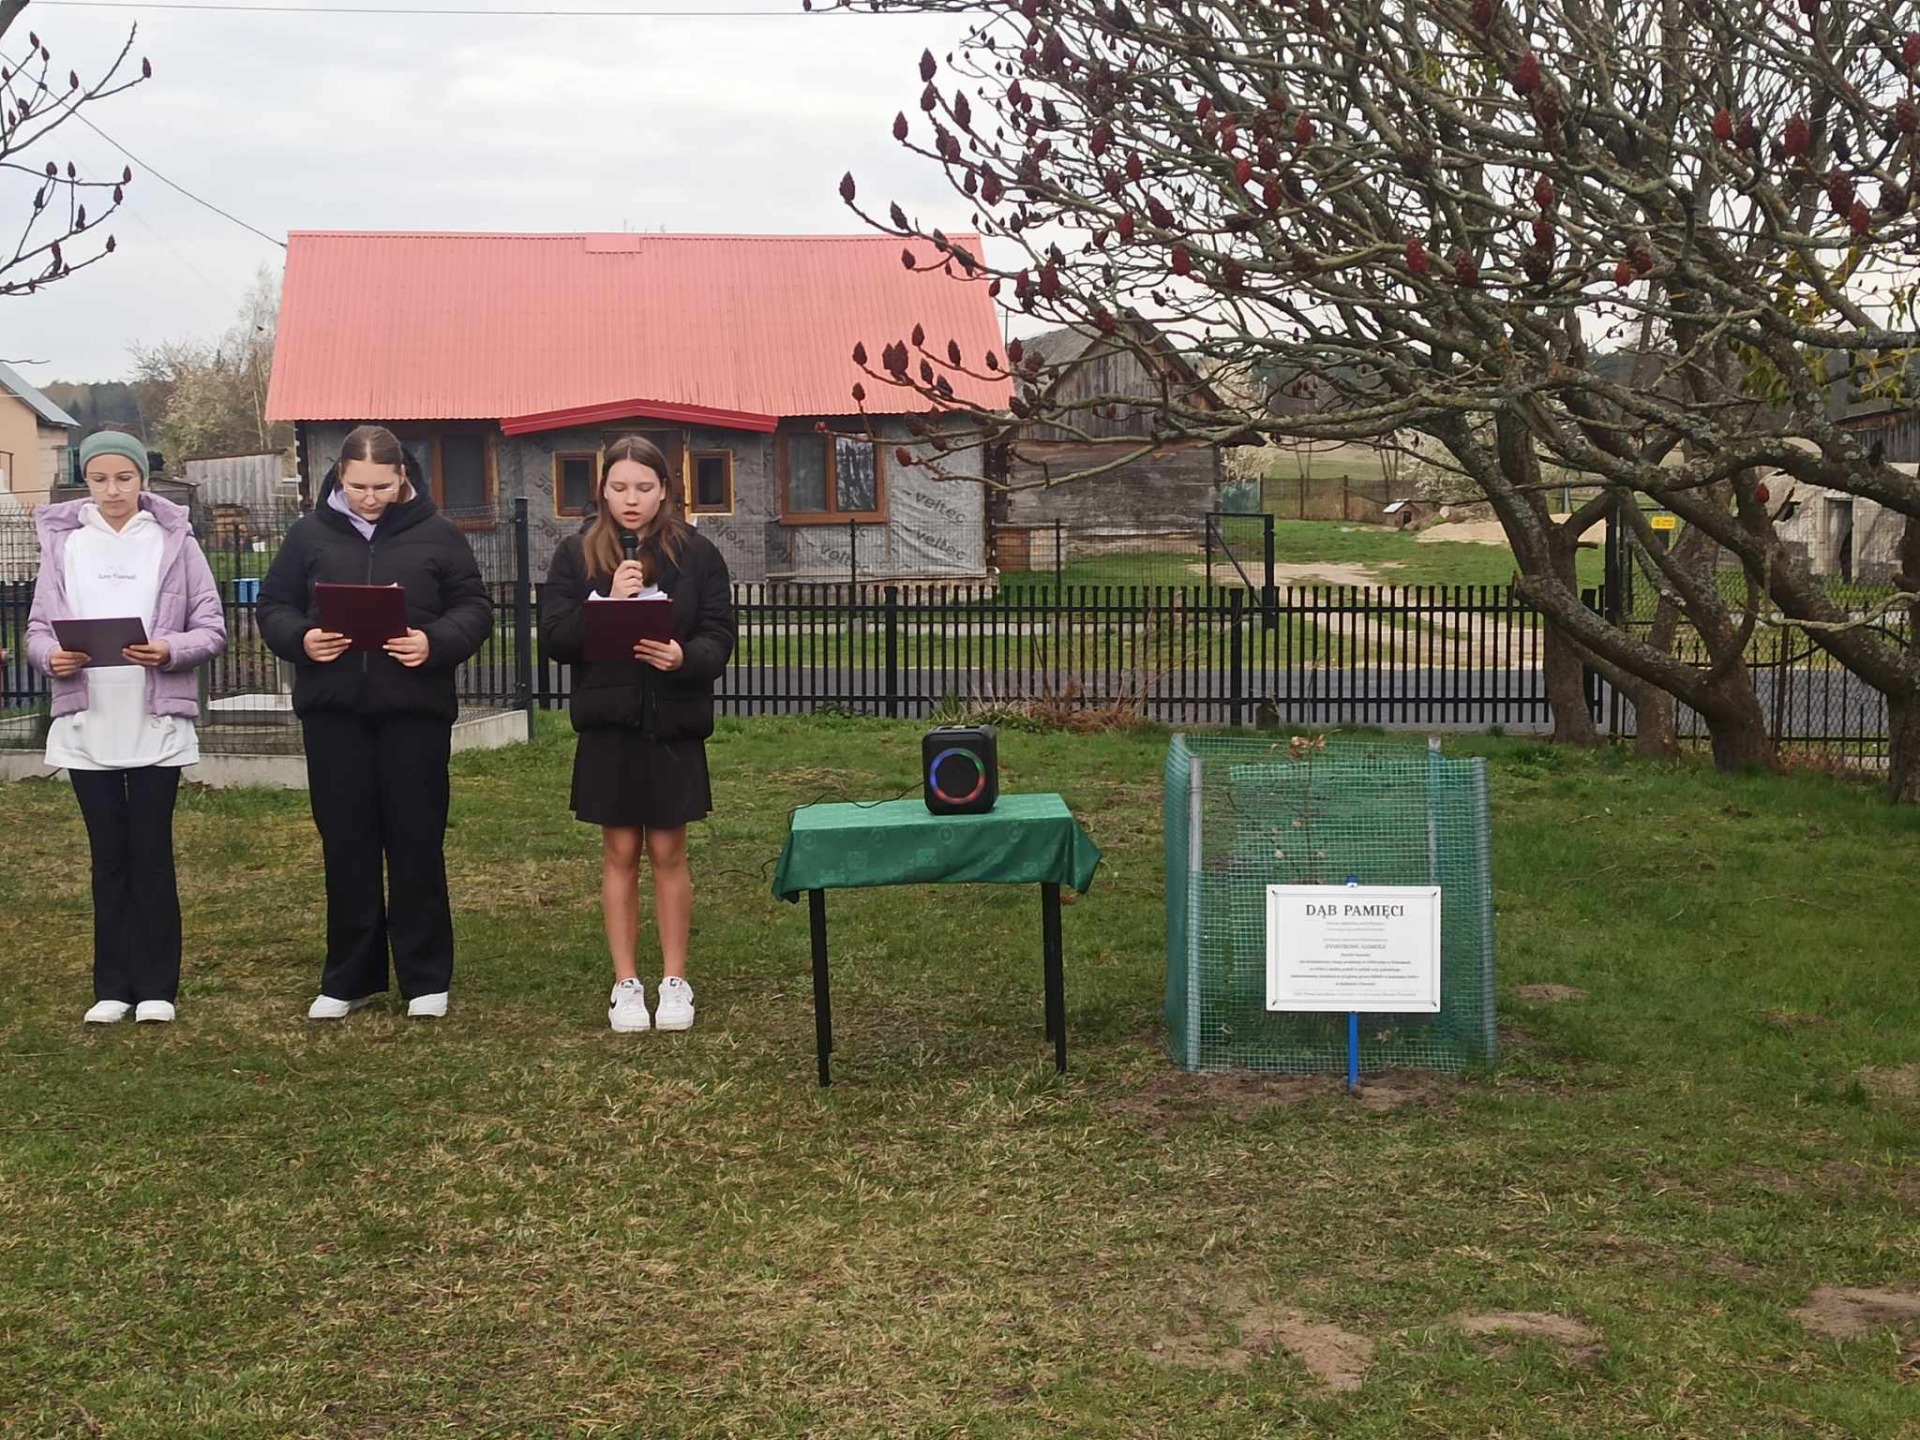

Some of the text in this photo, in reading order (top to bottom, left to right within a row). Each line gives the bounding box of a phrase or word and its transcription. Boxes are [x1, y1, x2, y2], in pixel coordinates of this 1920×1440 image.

[915, 492, 966, 524] veltec
[1305, 904, 1404, 919] DĄB PAMIĘCI
